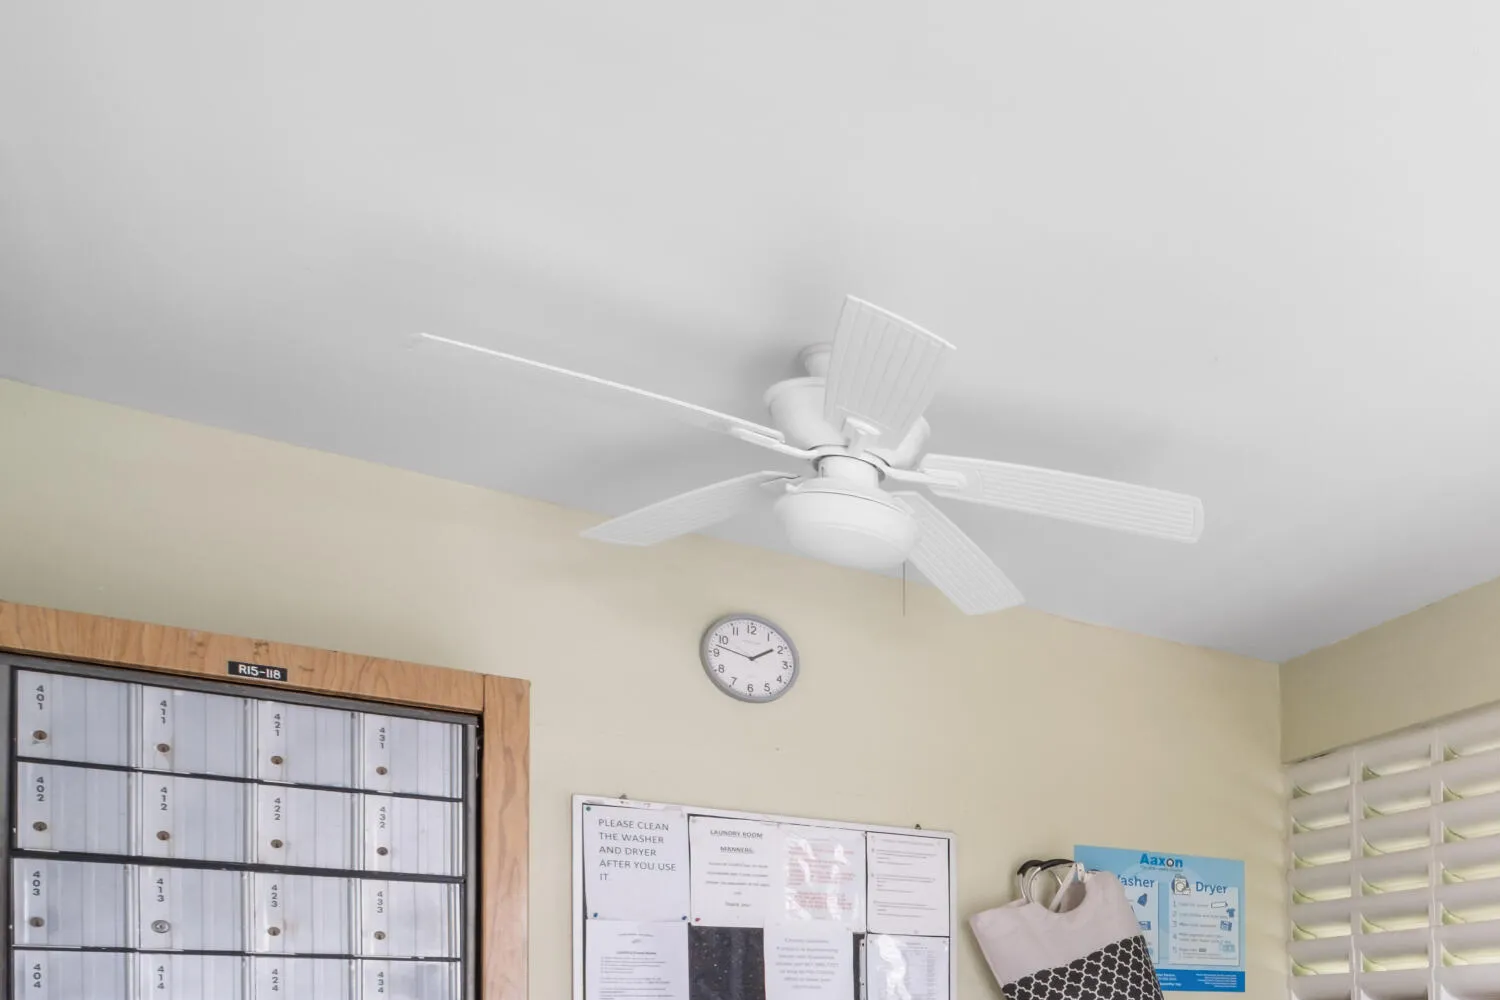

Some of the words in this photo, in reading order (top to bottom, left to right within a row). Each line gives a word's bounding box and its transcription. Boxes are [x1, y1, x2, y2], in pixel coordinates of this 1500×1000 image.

[732, 626, 739, 636] 11
[747, 625, 757, 635] 12
[719, 635, 729, 645] 10
[713, 648, 720, 657] 9
[777, 645, 783, 654] 2
[718, 664, 725, 673] 8
[782, 661, 788, 670] 3
[731, 676, 737, 685] 7
[776, 675, 782, 683] 4
[747, 684, 754, 692] 6
[764, 683, 770, 692] 5
[35, 685, 44, 711] 401
[159, 700, 168, 724] 411
[273, 713, 281, 737] 421
[378, 727, 386, 749] 431
[35, 776, 45, 802] 402
[160, 787, 168, 811] 412
[273, 798, 281, 821] 422
[598, 818, 634, 829] PLEASE
[637, 821, 669, 831] CLEAN
[599, 832, 618, 841] THE
[621, 833, 664, 844] WASHER
[599, 846, 622, 854] AND
[625, 848, 657, 856] DRYER
[599, 859, 631, 868] AFTER
[634, 861, 654, 870] YOU
[658, 863, 676, 871] USE
[1140, 853, 1183, 868] Aaxon
[32, 871, 41, 896] 403
[1117, 874, 1155, 888] asher
[156, 878, 164, 902] 413
[1195, 881, 1228, 896] Dryer
[270, 885, 279, 908] 423
[32, 963, 41, 989] 404
[157, 965, 165, 990] 414
[271, 968, 279, 992] 424
